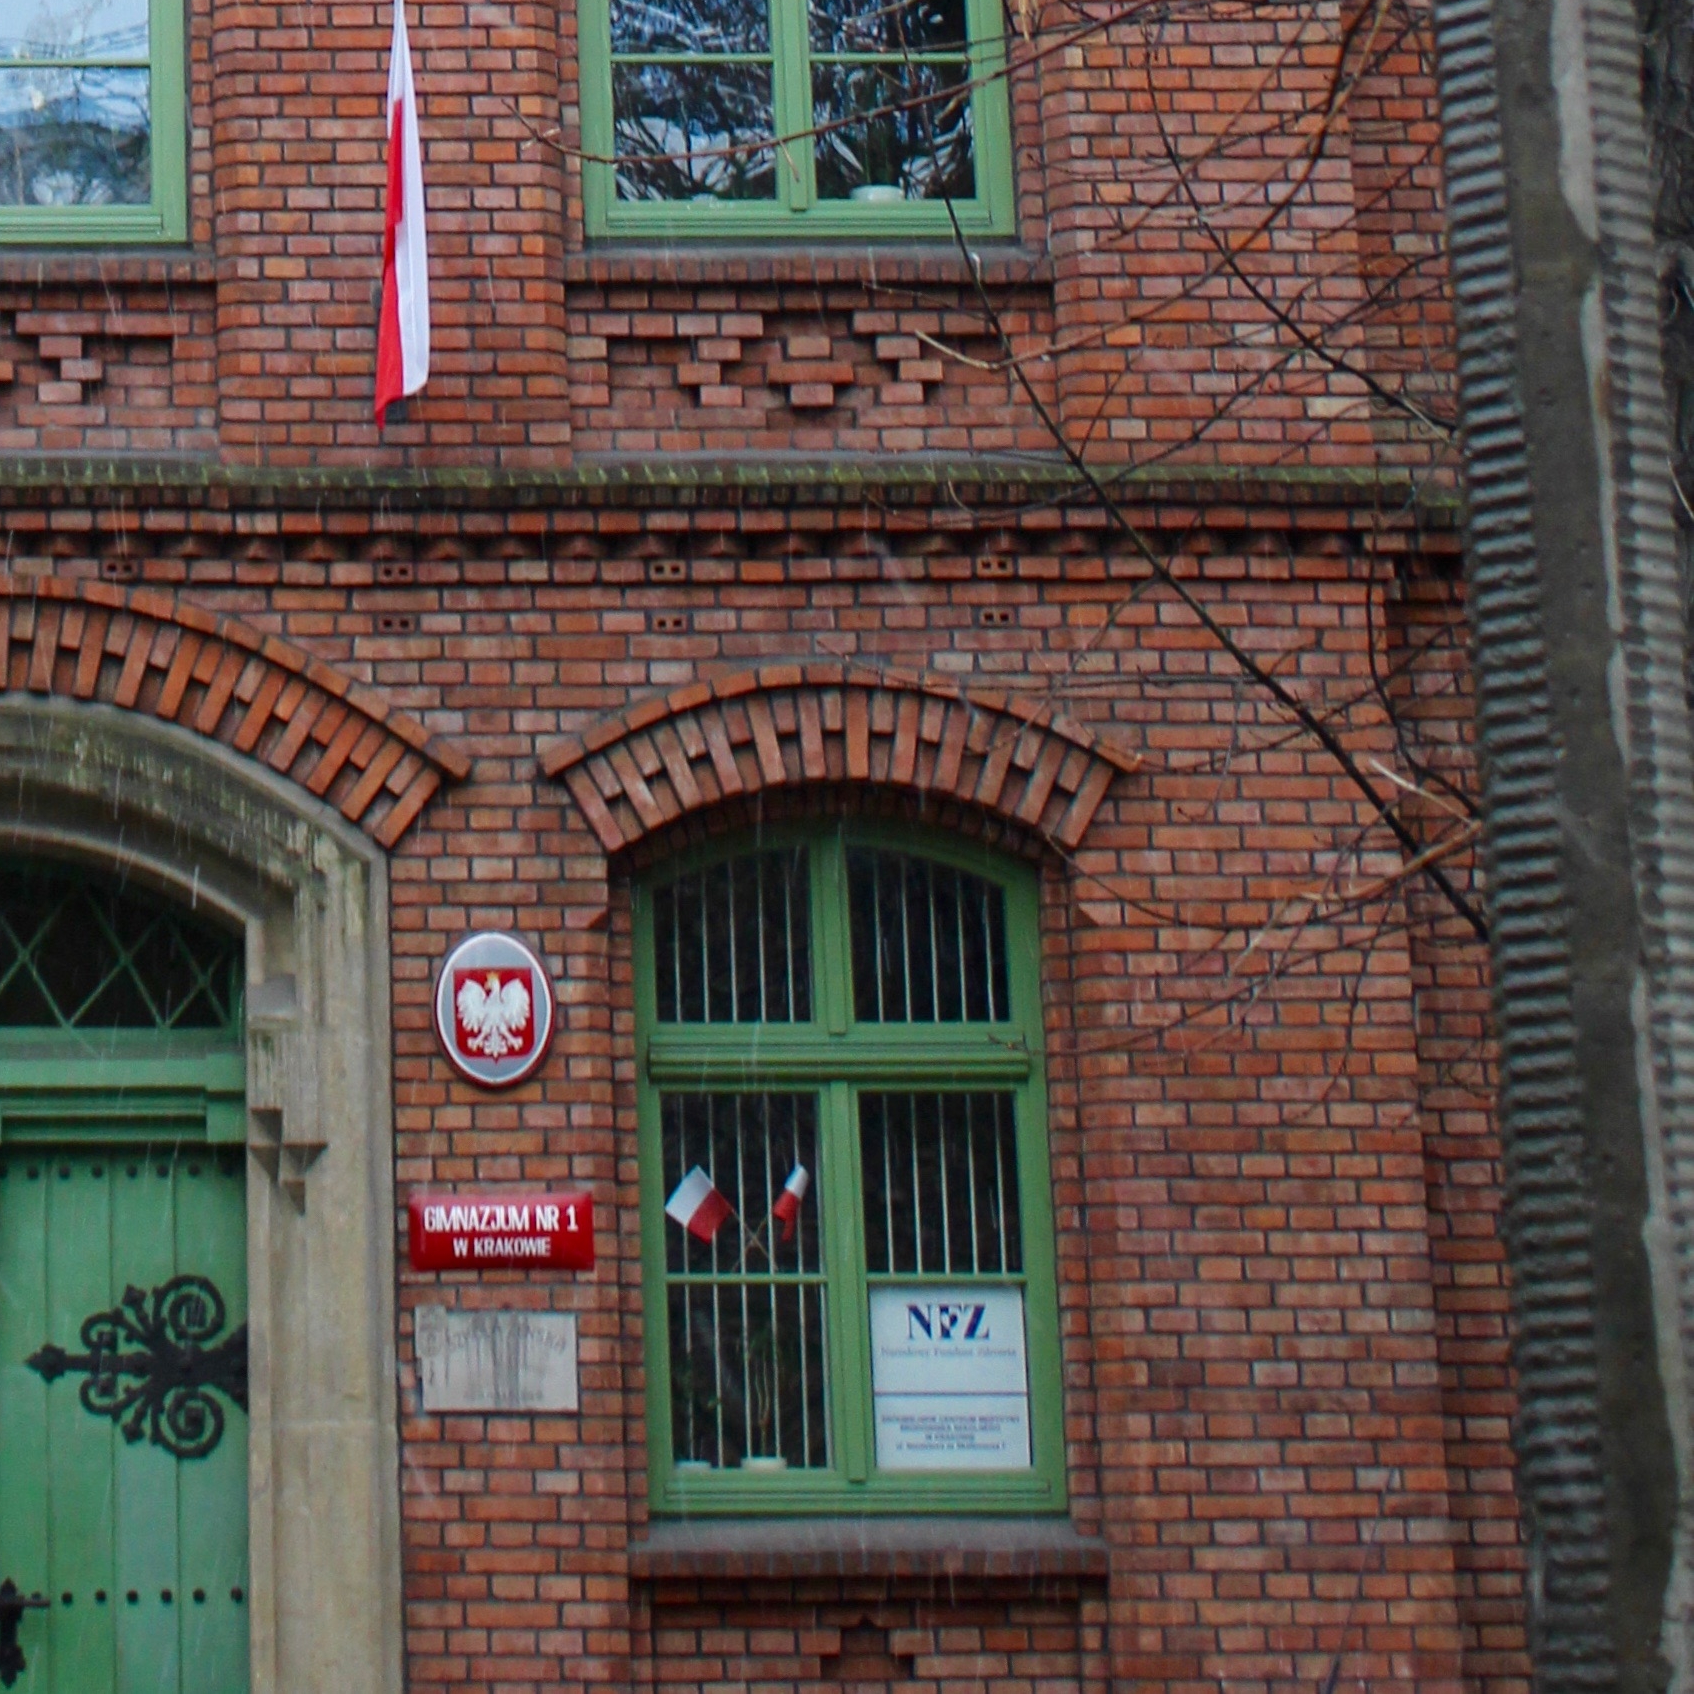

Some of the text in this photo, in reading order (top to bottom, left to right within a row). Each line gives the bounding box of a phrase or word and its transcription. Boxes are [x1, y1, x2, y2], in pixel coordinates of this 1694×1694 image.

[423, 1205, 579, 1233] GIMNAZJUM NR 1
[453, 1236, 552, 1258] W KRAKOWIE
[906, 1304, 990, 1340] NFZ
